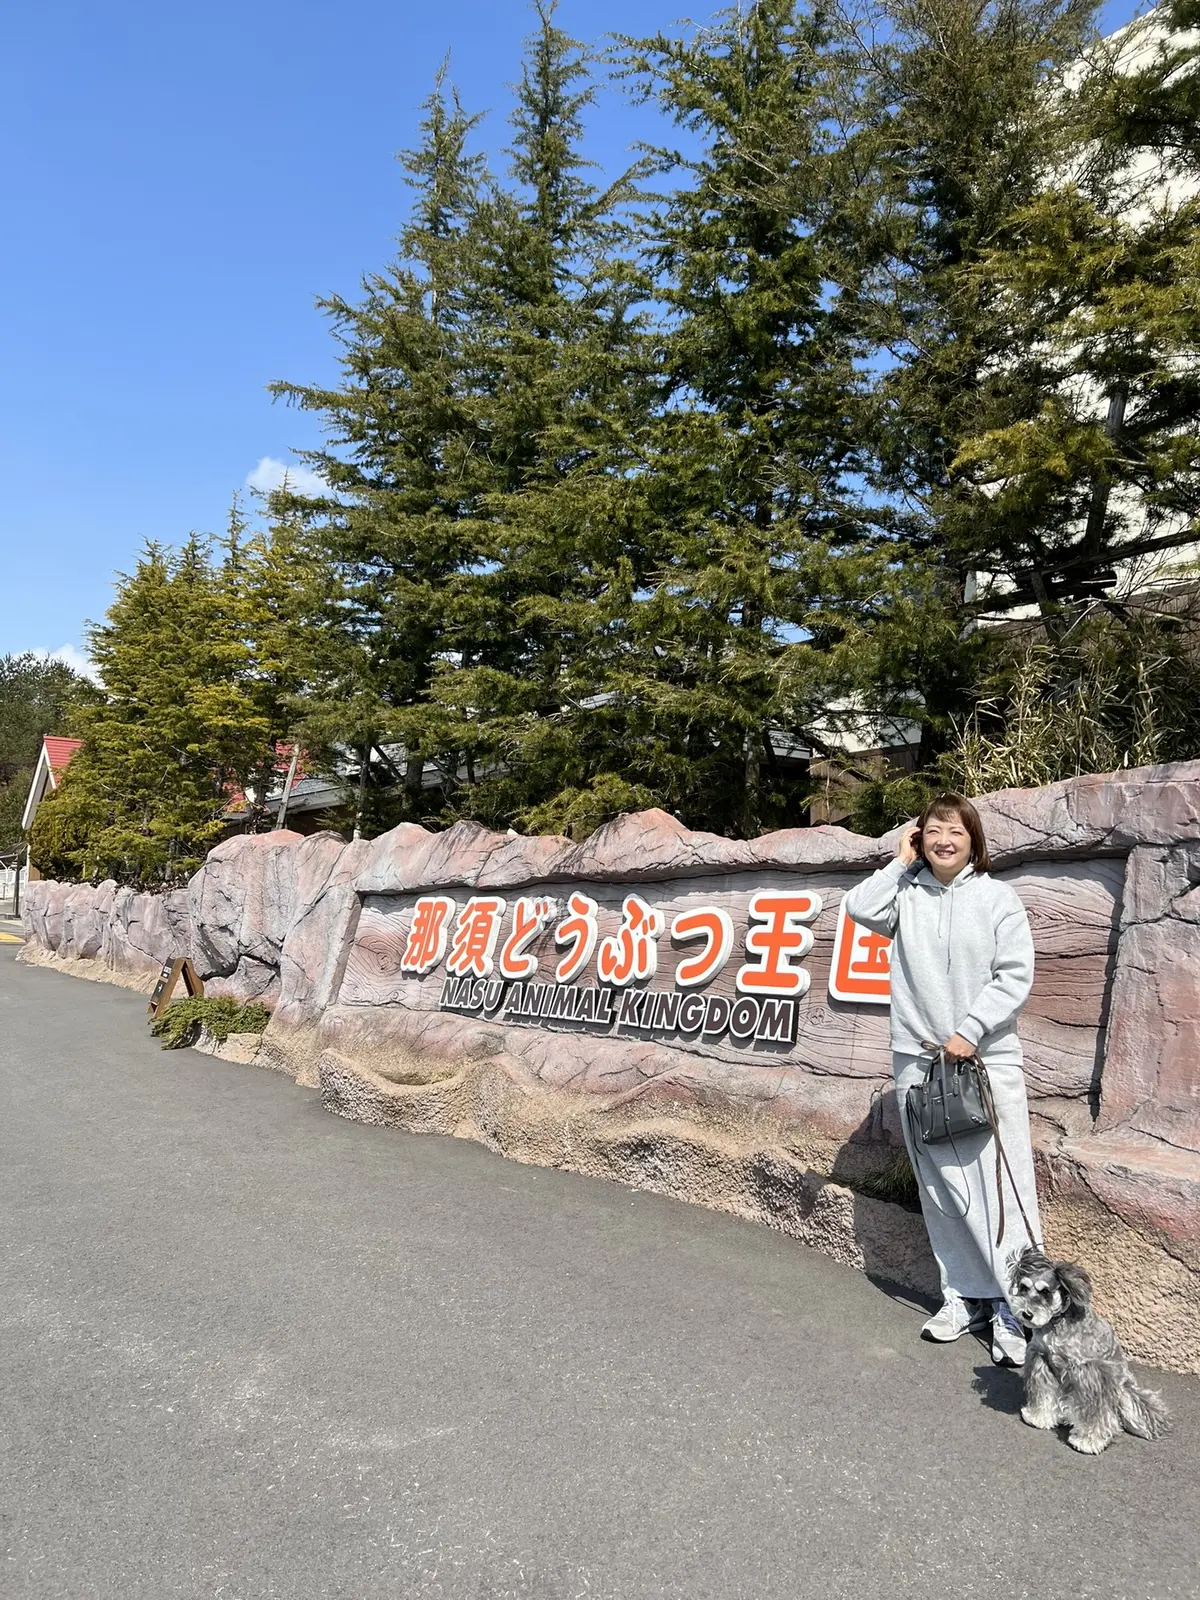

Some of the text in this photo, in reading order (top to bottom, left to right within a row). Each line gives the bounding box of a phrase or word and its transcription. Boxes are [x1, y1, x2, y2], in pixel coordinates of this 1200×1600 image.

[442, 977, 795, 1043] NASU ANIMAL KINGDOM
